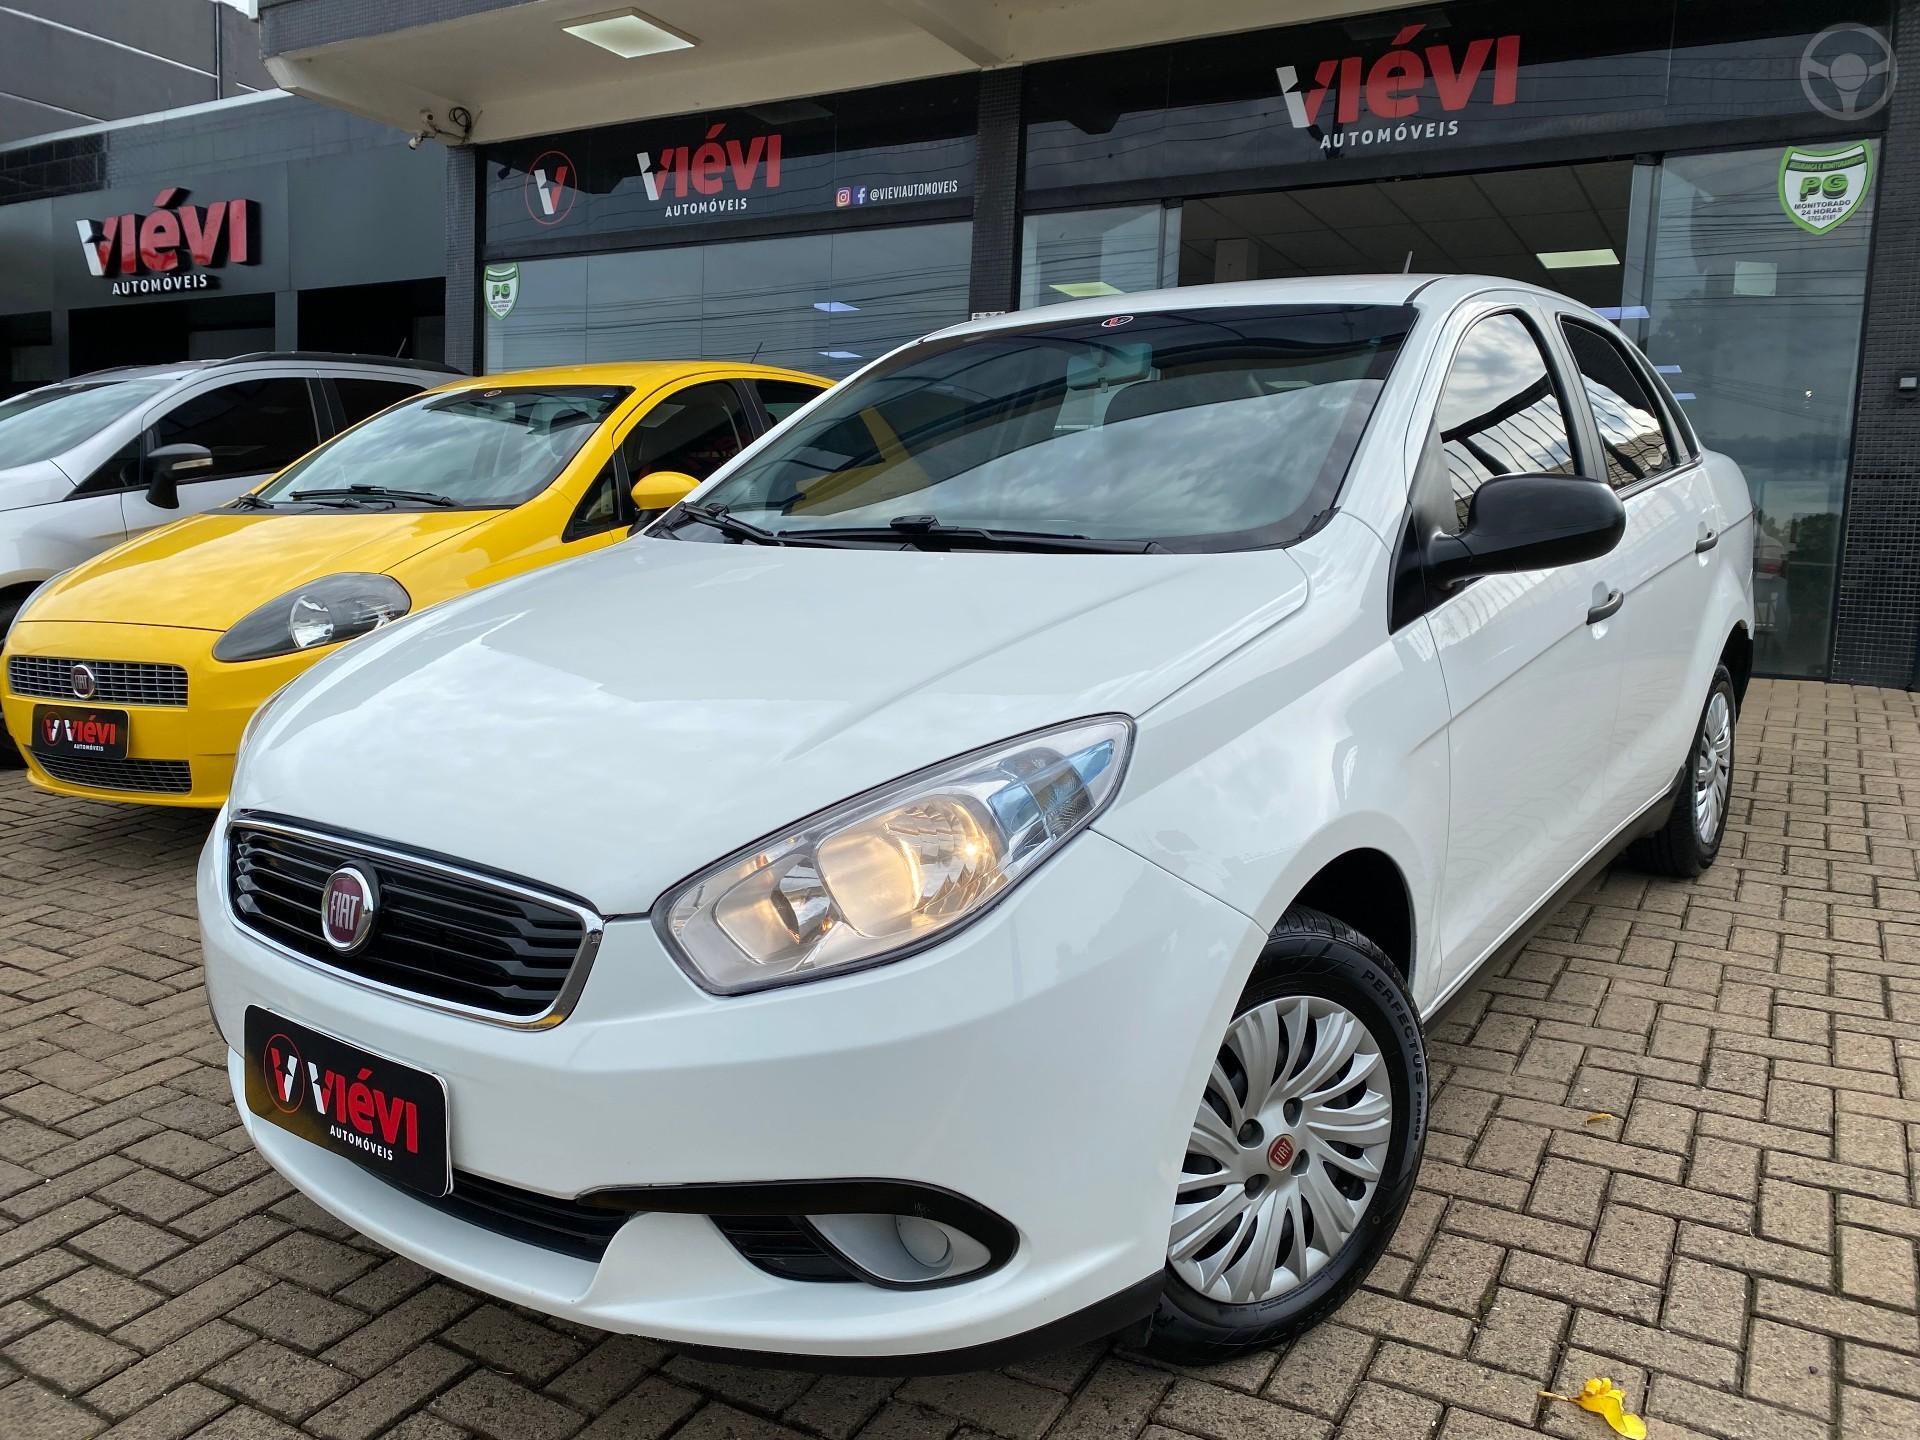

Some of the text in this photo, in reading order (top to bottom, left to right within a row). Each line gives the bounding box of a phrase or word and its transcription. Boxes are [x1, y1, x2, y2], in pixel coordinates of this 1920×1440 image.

[1319, 121, 1459, 149] AUTOMÓVEIS
[870, 180, 958, 200] @VIEVIAUTOMOVEIS
[1800, 174, 1848, 201] PG
[665, 198, 748, 217] AUTOMÓVEIS
[1794, 199, 1851, 210] MONITORADO
[1801, 206, 1843, 216] 24 HORAS
[112, 273, 208, 295] AUTOMÓVEIS
[74, 674, 88, 690] FIAT
[73, 743, 104, 752] AUTOMÓVEIS
[329, 890, 360, 931] FIAT
[1361, 968, 1424, 1086] PERFECTUS
[329, 1124, 393, 1161] AUTOMÓVEIS
[1273, 1140, 1291, 1164] FIAT
